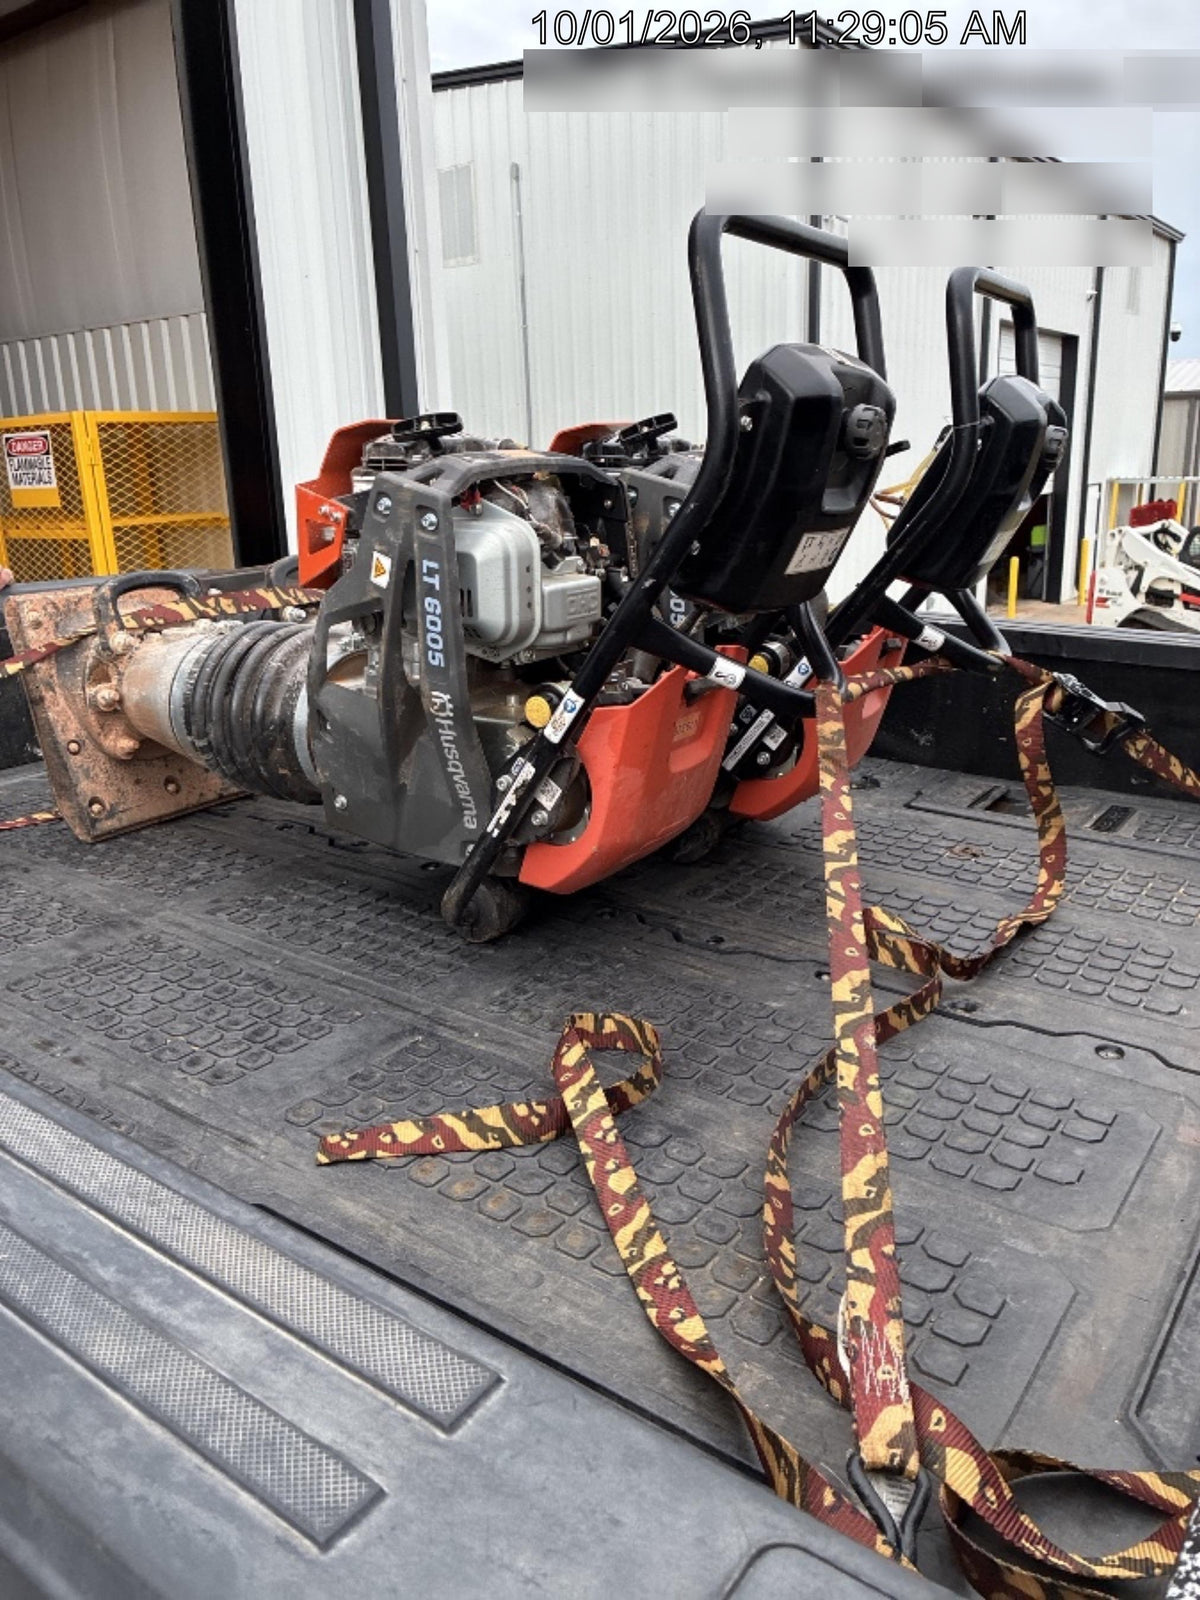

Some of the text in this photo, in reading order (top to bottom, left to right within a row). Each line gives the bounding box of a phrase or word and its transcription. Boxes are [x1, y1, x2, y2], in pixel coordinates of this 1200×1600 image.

[11, 440, 43, 453] DANGER
[9, 456, 52, 472] FLAMMABLE
[12, 470, 53, 486] MATERIALS
[422, 559, 446, 668] LT 6005
[434, 717, 478, 830] Husqvarna
